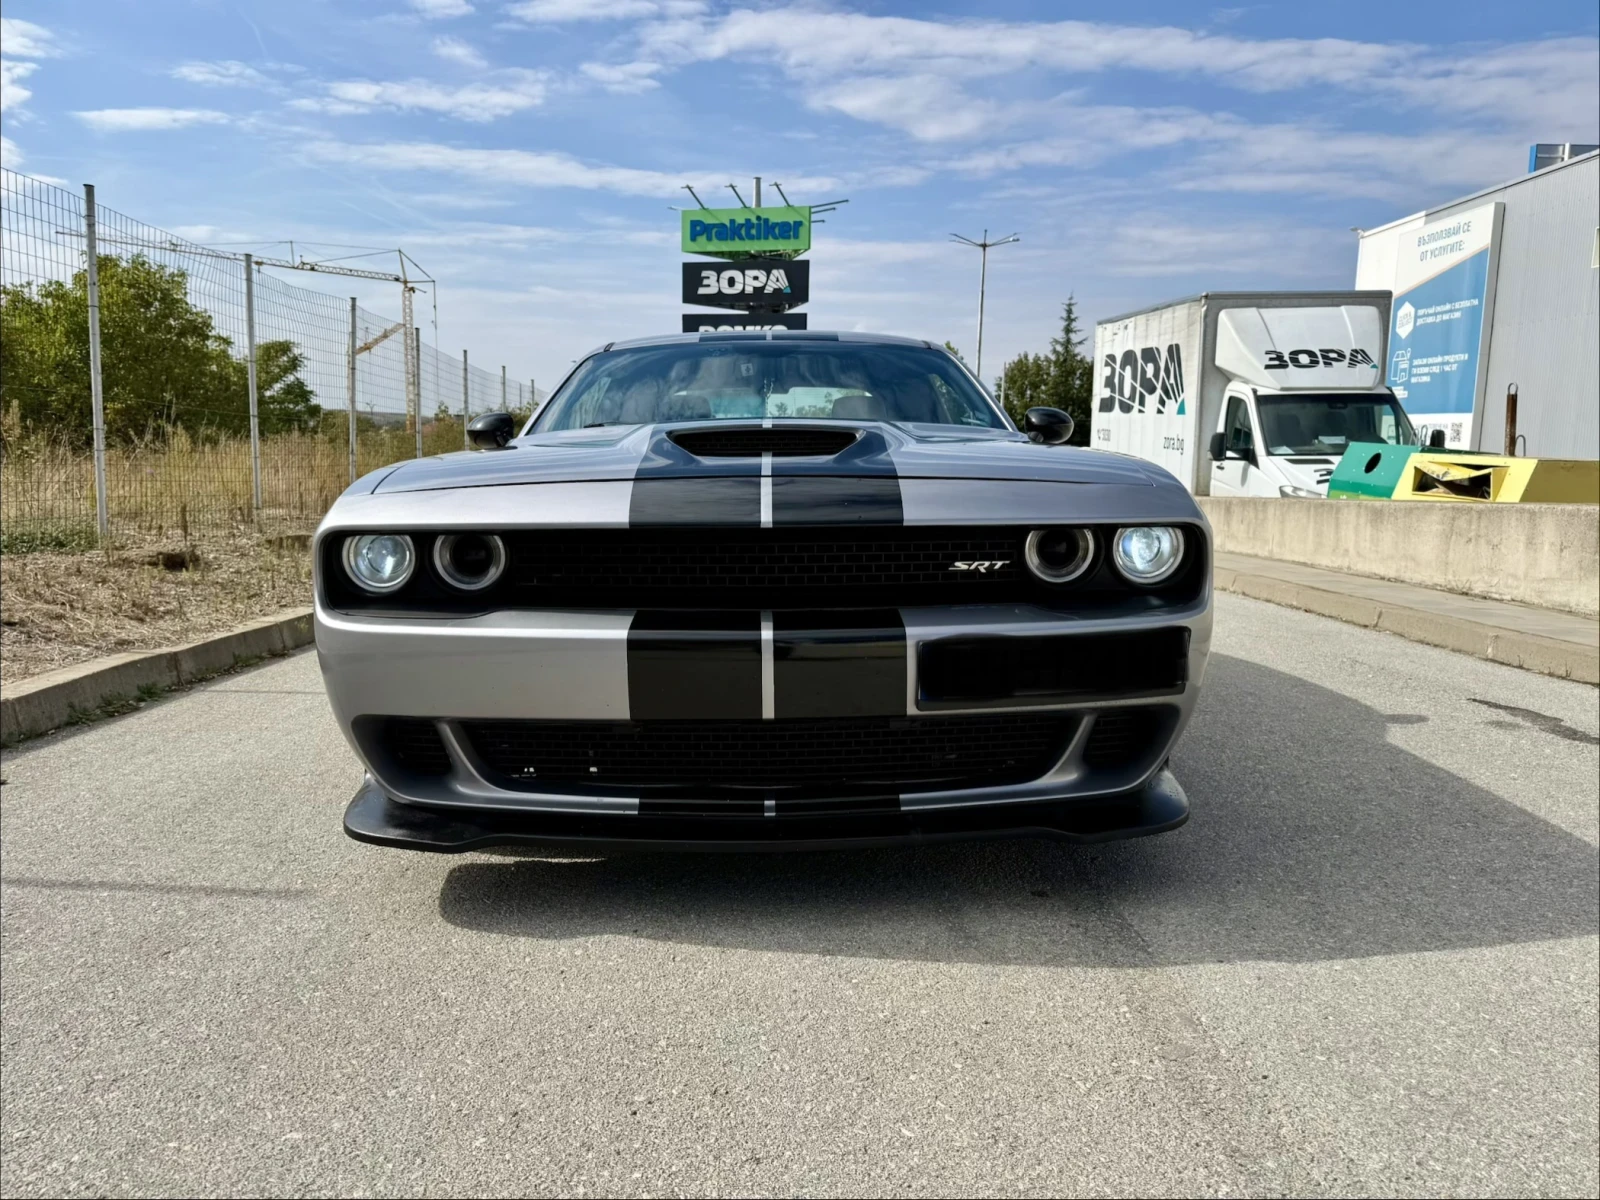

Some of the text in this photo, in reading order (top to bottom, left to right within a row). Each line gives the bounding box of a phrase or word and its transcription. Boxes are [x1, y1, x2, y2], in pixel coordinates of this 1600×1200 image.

[690, 215, 803, 242] Praktiker
[1417, 220, 1472, 247] ВЪЗПОЛЗВАЙ СЕ
[1419, 240, 1465, 262] ОТ УСЛУГИТЕ:
[697, 269, 791, 295] ЗОРА
[1264, 348, 1379, 370] ЗОРА
[1098, 343, 1186, 415] ЗОРА
[1163, 433, 1184, 455] zora.bg
[948, 560, 1010, 573] SRT
